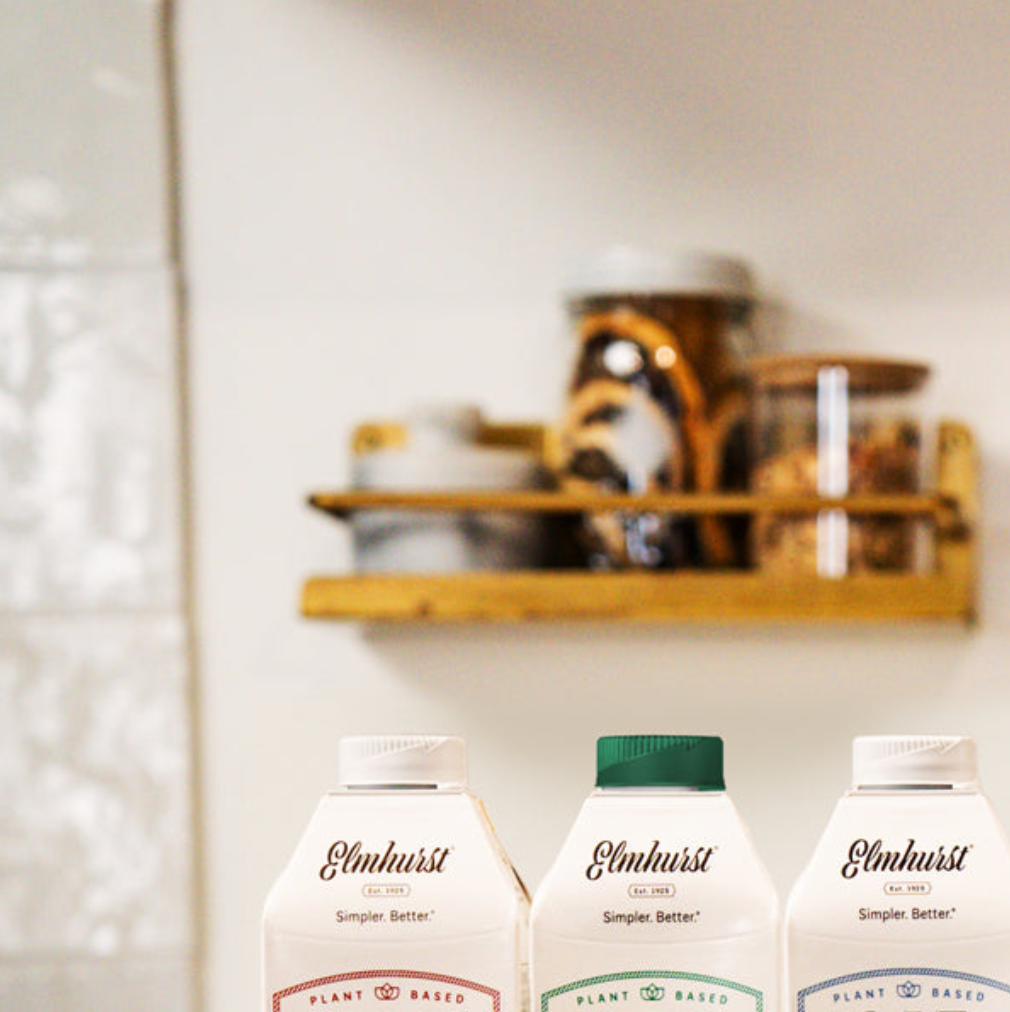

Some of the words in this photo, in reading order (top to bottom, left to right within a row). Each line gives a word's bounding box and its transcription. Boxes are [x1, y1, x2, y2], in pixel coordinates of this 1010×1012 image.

[319, 841, 450, 881] Elmhurst
[586, 840, 714, 880] Elmhurst
[841, 839, 969, 879] Elmhurst
[336, 910, 386, 925] Simpler.
[604, 911, 653, 925] Simpler.
[859, 908, 908, 922] Simpler.
[310, 990, 362, 1005] PLANT
[410, 990, 464, 1004] BASED
[577, 991, 629, 1006] PLANT
[676, 991, 727, 1004] BASED
[834, 988, 885, 1002] PLANT
[932, 988, 984, 1002] BASED
